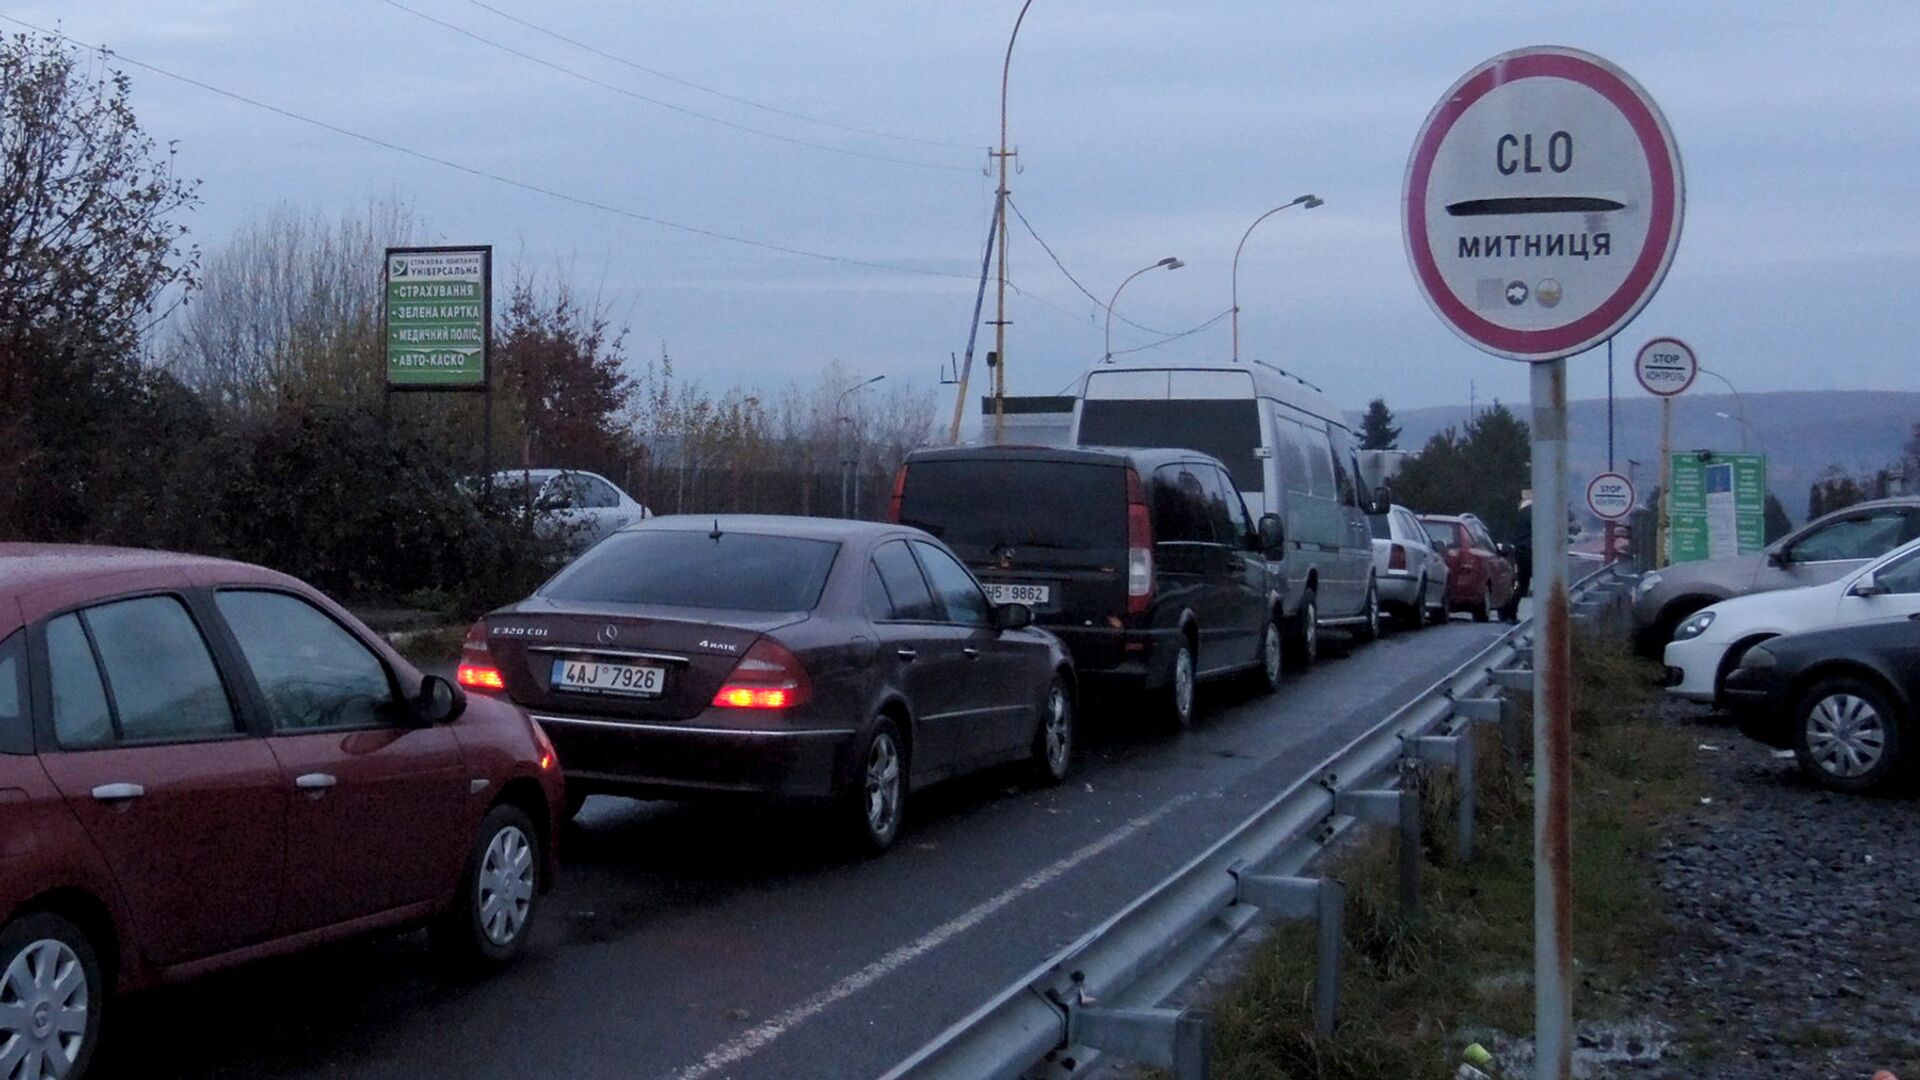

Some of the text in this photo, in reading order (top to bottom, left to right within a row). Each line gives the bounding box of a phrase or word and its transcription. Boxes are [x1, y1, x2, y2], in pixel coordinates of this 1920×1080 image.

[1496, 130, 1573, 176] CLO
[1458, 233, 1611, 260] МИТНИЦЯ
[410, 266, 478, 276] УНІВЕРСАЛЬНА
[400, 285, 473, 297] СТРАХУВАННЯ
[399, 305, 479, 318] ЗЕЛЕНА КАРТКА
[400, 327, 449, 343] МЕДИЧНИЙ
[1652, 353, 1680, 364] STOP
[1601, 485, 1622, 493] STOP
[1011, 586, 1042, 601] 9862
[501, 627, 524, 635] 320
[527, 628, 548, 636] CDI
[565, 663, 655, 689] 4AJ 7926
